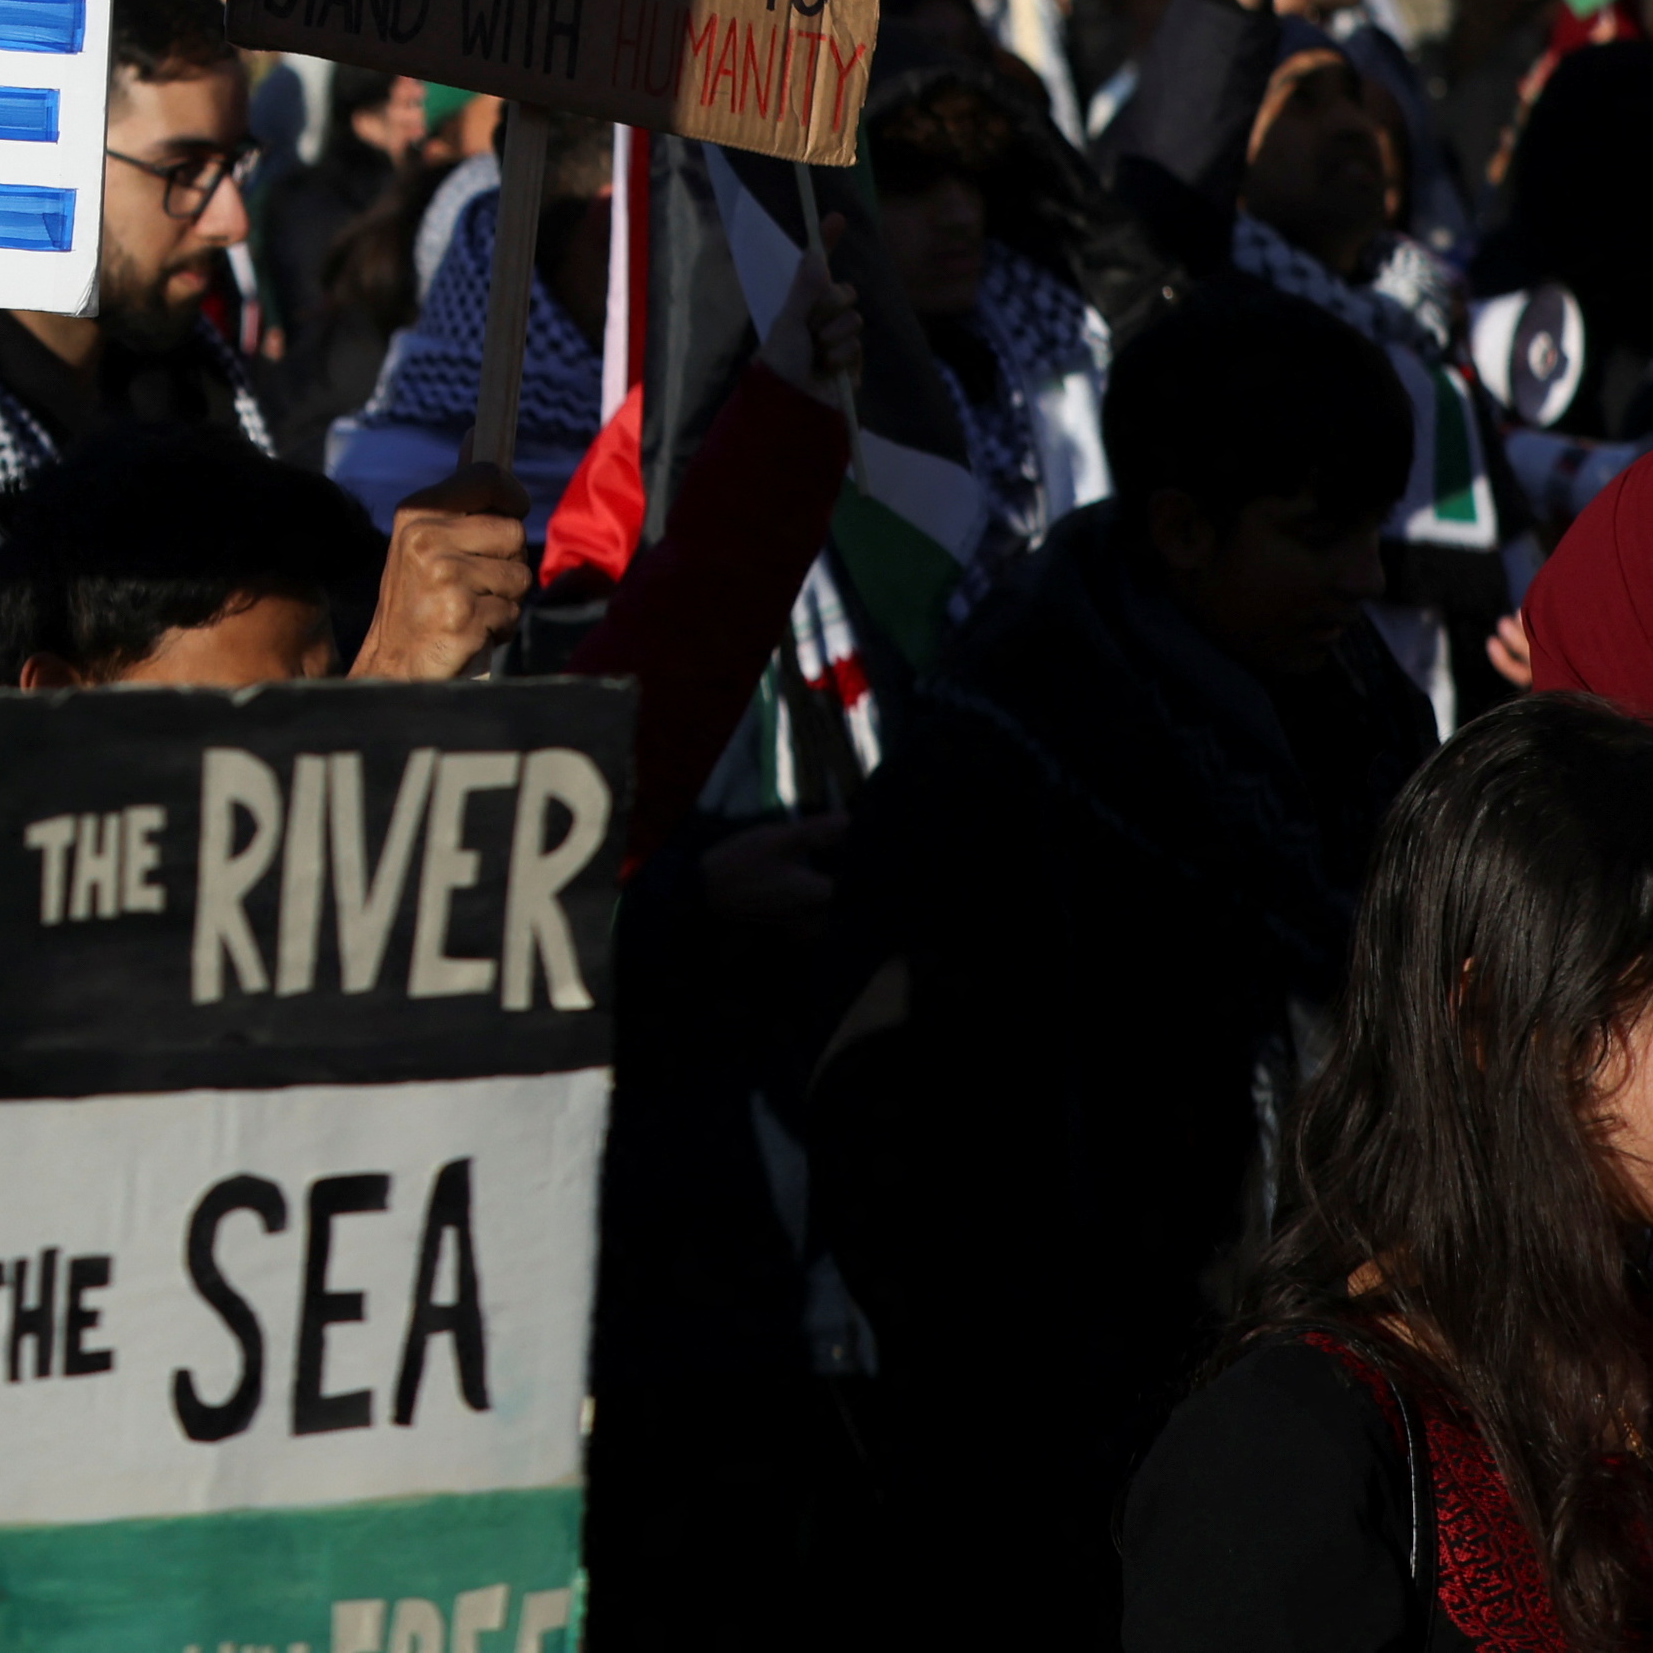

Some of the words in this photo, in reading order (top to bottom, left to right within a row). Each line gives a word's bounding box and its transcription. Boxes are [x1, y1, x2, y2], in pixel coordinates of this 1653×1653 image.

[26, 805, 167, 926] THE
[190, 747, 612, 1011] RIVER
[171, 1157, 492, 1444] SEA
